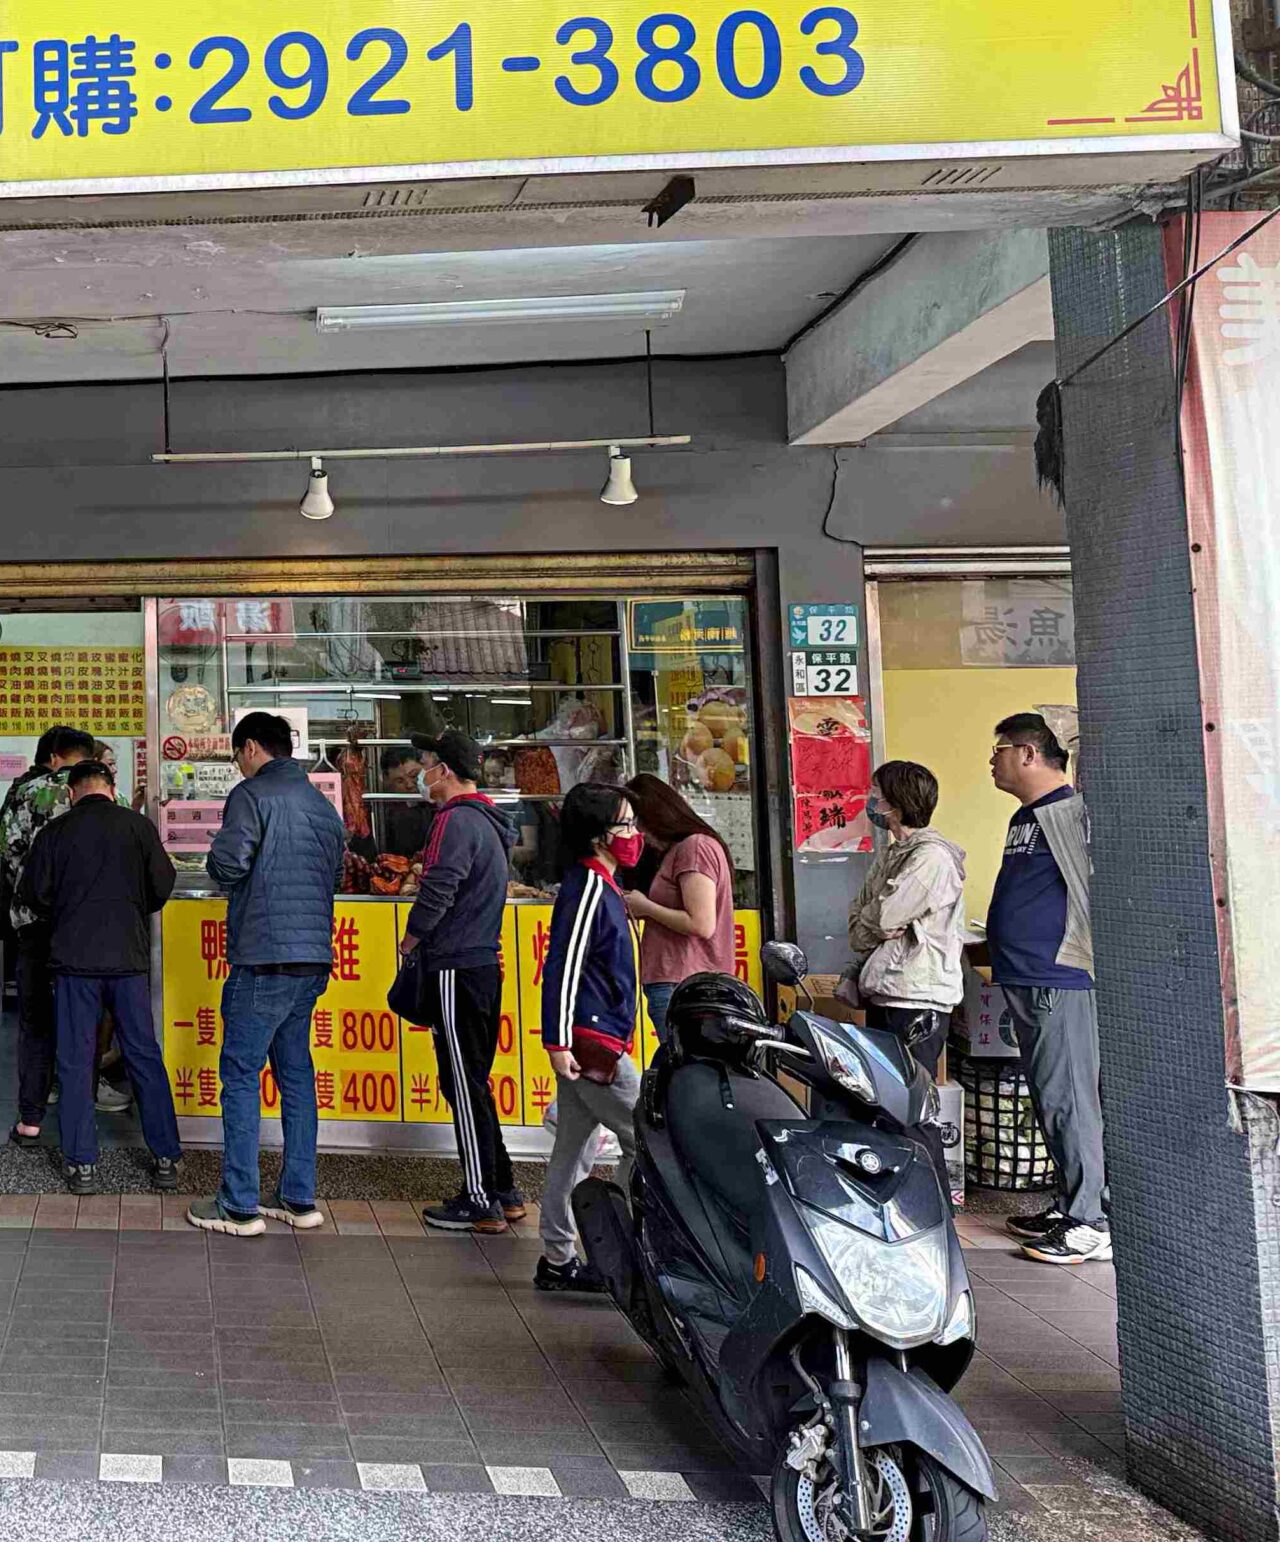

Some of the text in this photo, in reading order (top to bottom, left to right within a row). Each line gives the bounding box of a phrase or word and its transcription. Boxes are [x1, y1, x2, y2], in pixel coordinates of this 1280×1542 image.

[819, 619, 847, 642] 32
[794, 655, 805, 692] 永和區
[811, 653, 851, 664] 保平路
[814, 668, 851, 692] 32
[342, 1011, 395, 1051] 800
[343, 1073, 397, 1113] 400
